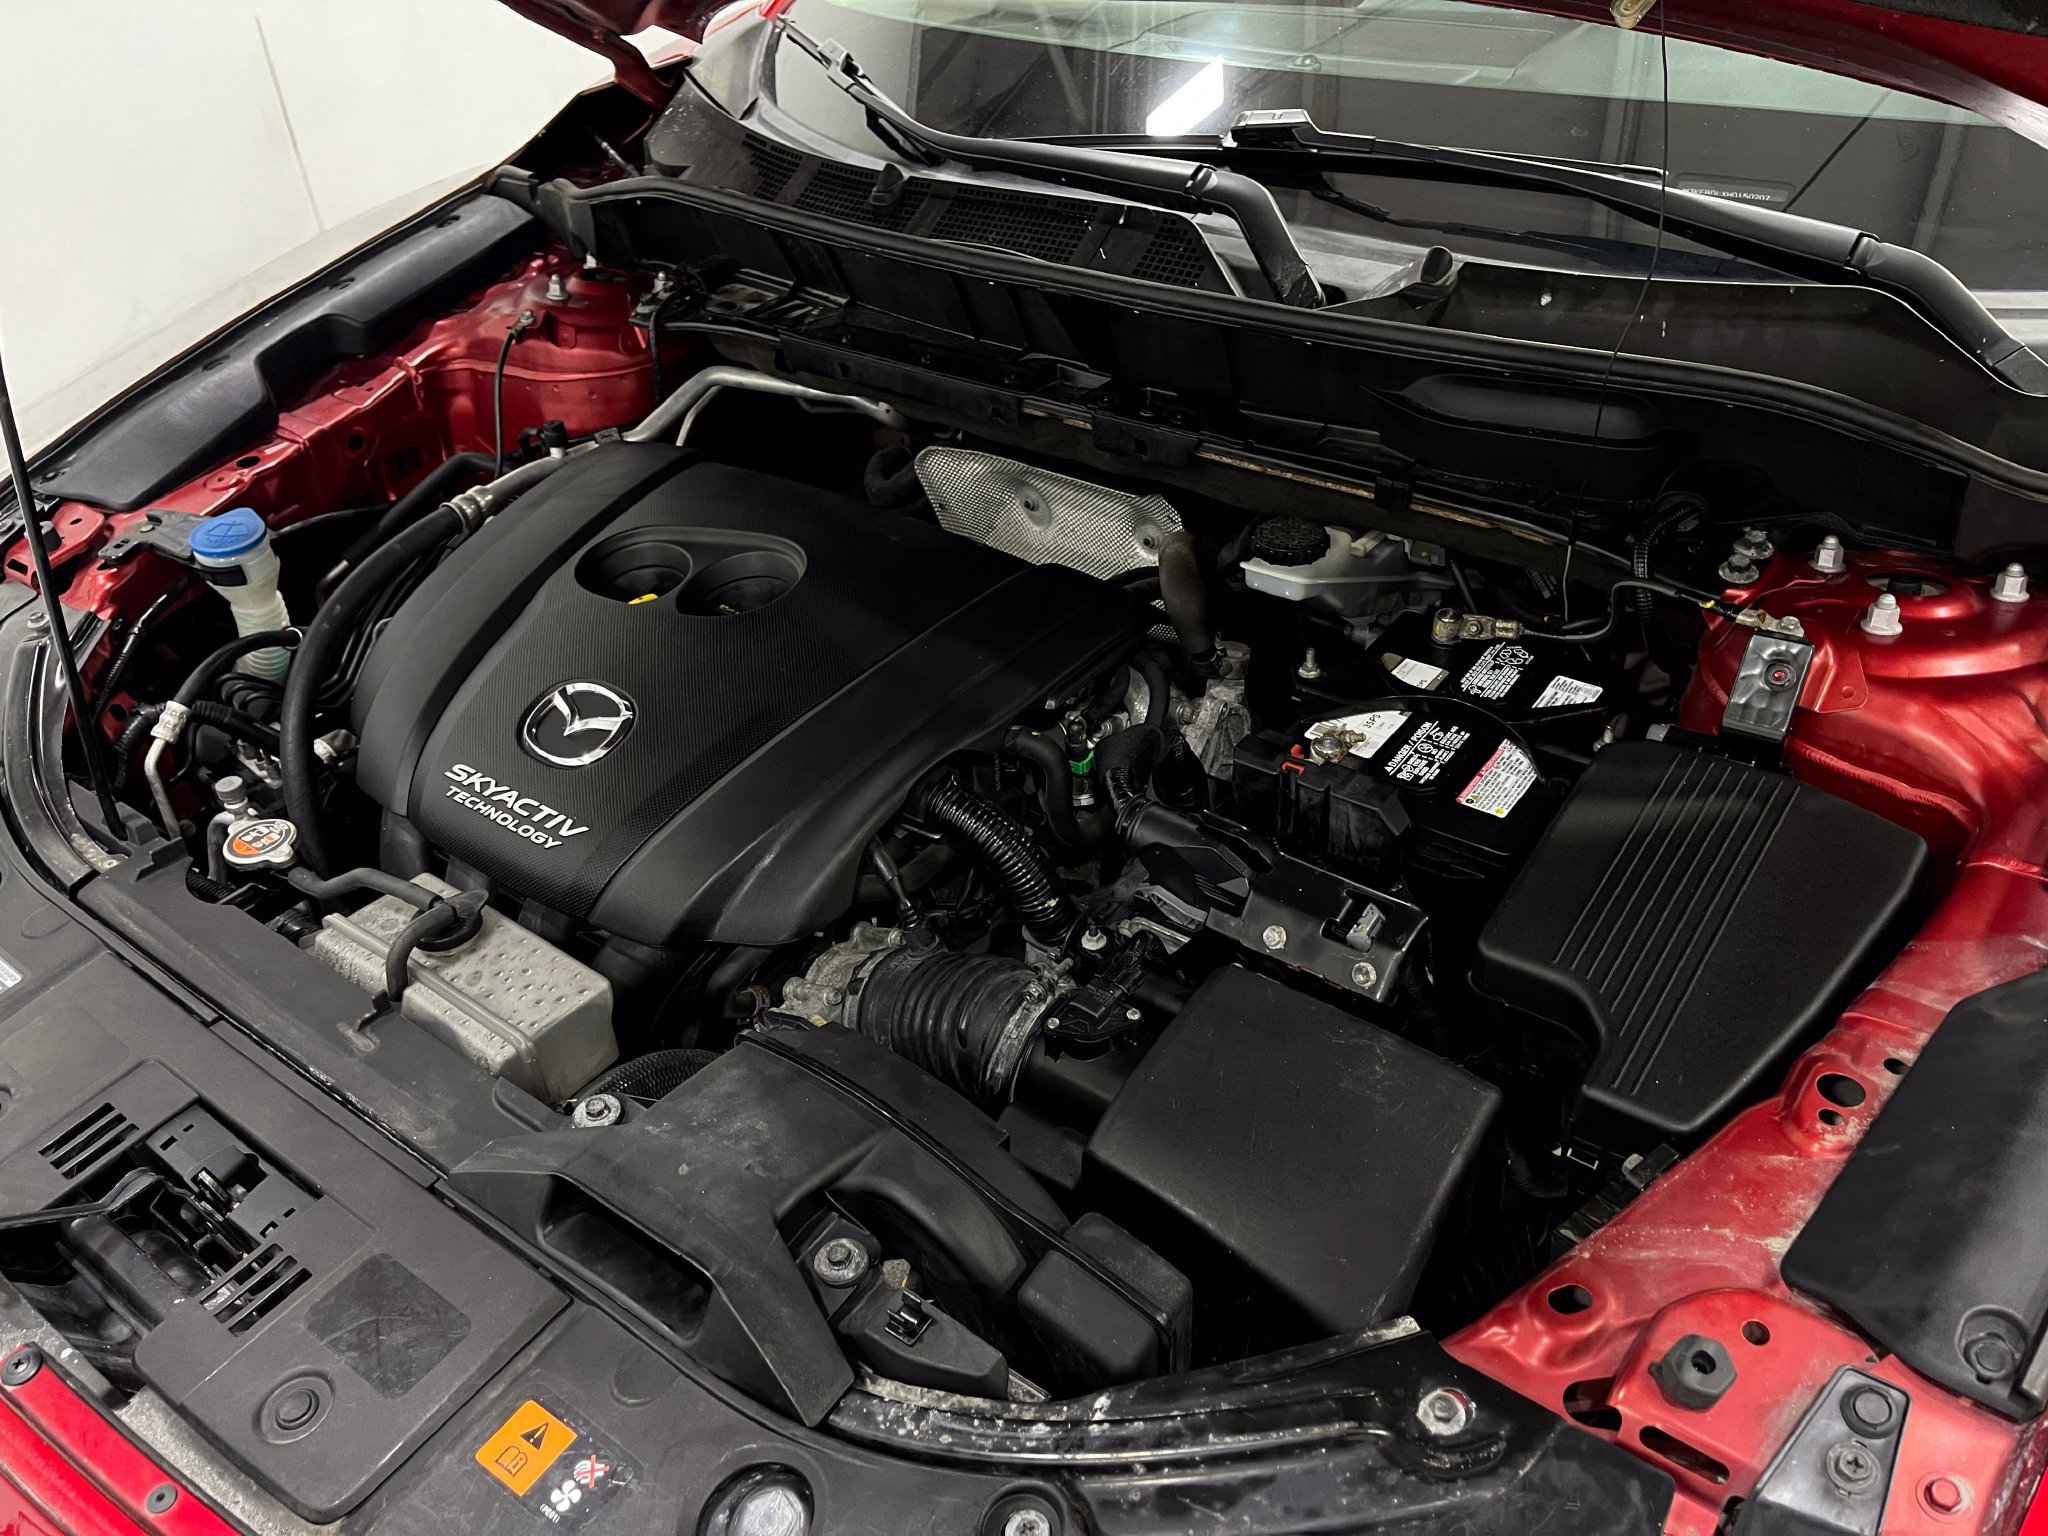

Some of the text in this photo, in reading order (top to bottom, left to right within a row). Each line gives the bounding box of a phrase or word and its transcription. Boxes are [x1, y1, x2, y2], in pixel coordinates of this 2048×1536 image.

[1362, 713, 1382, 730] 35PS
[1388, 744, 1412, 767] DANGER
[1410, 721, 1433, 742] POISON
[444, 763, 590, 838] SKYACTIV
[445, 785, 563, 849] TECHNOLOGY
